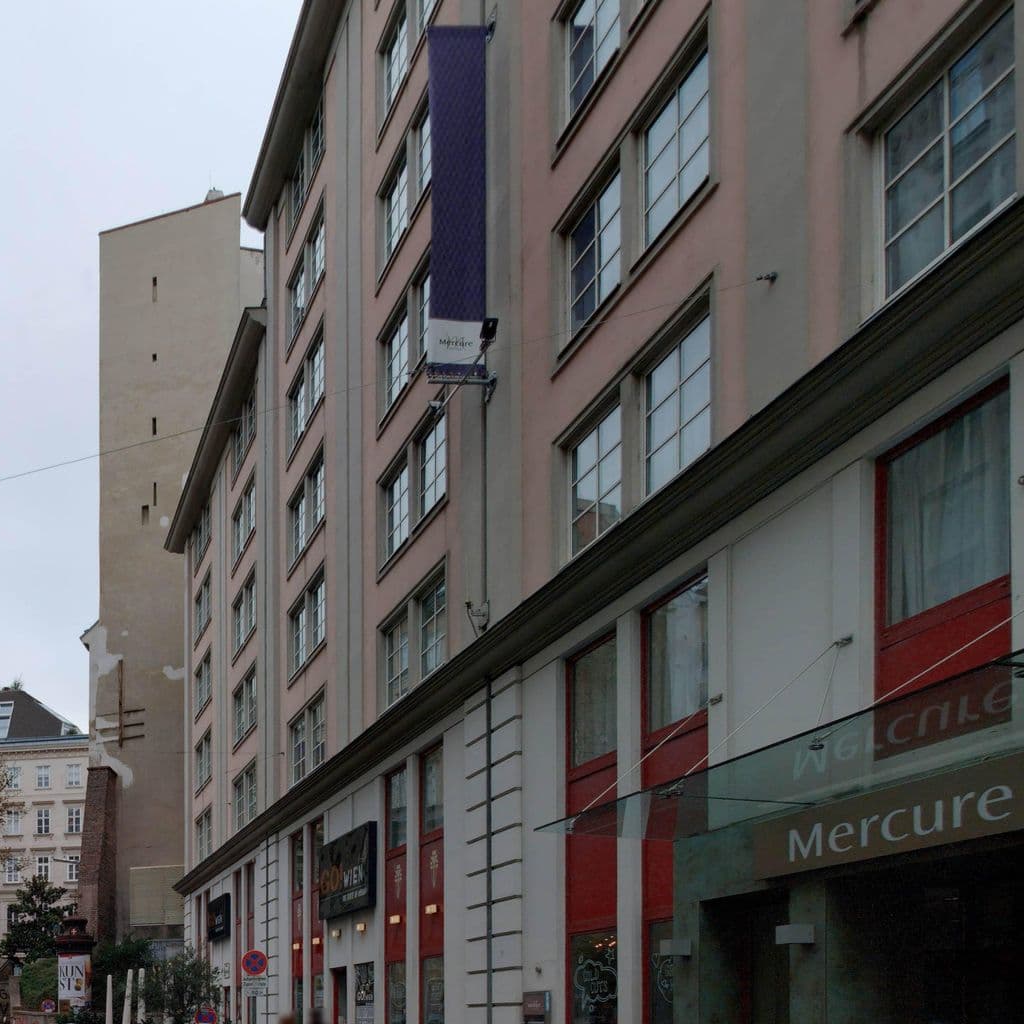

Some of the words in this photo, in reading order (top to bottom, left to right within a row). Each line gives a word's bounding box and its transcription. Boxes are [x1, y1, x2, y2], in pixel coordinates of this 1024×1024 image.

[439, 338, 474, 348] Mercure
[788, 784, 1014, 862] Mercure
[343, 864, 364, 888] WIEN
